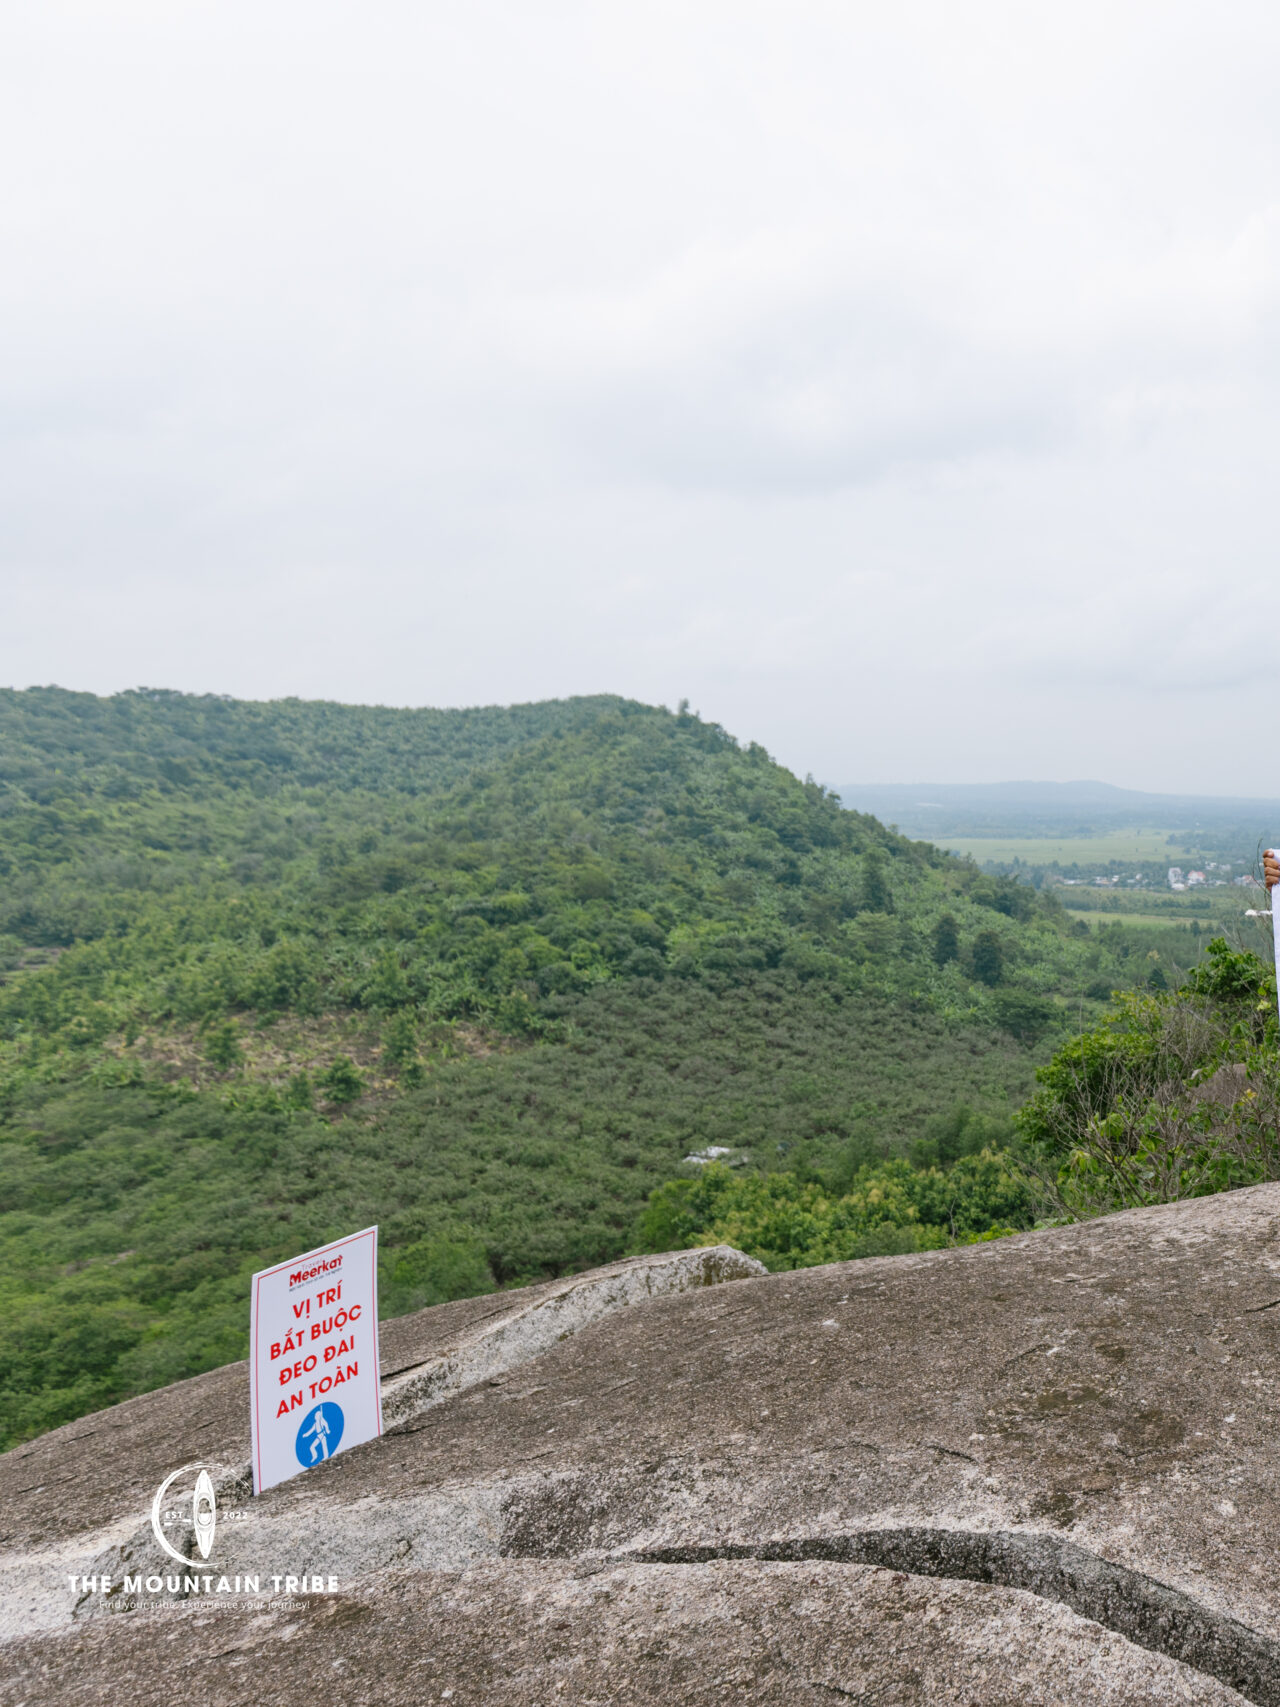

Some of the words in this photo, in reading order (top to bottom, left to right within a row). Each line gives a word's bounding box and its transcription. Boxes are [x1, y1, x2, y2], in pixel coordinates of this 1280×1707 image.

[289, 1254, 343, 1287] Meerkat
[292, 1298, 310, 1319] VỊ
[316, 1279, 343, 1308] TRÍ
[270, 1327, 305, 1361] BẮT
[311, 1304, 362, 1341] BUỘC
[279, 1354, 318, 1386] ĐEO
[323, 1335, 354, 1363] ĐAI
[276, 1390, 303, 1419] AN
[309, 1361, 358, 1399] TOÀN
